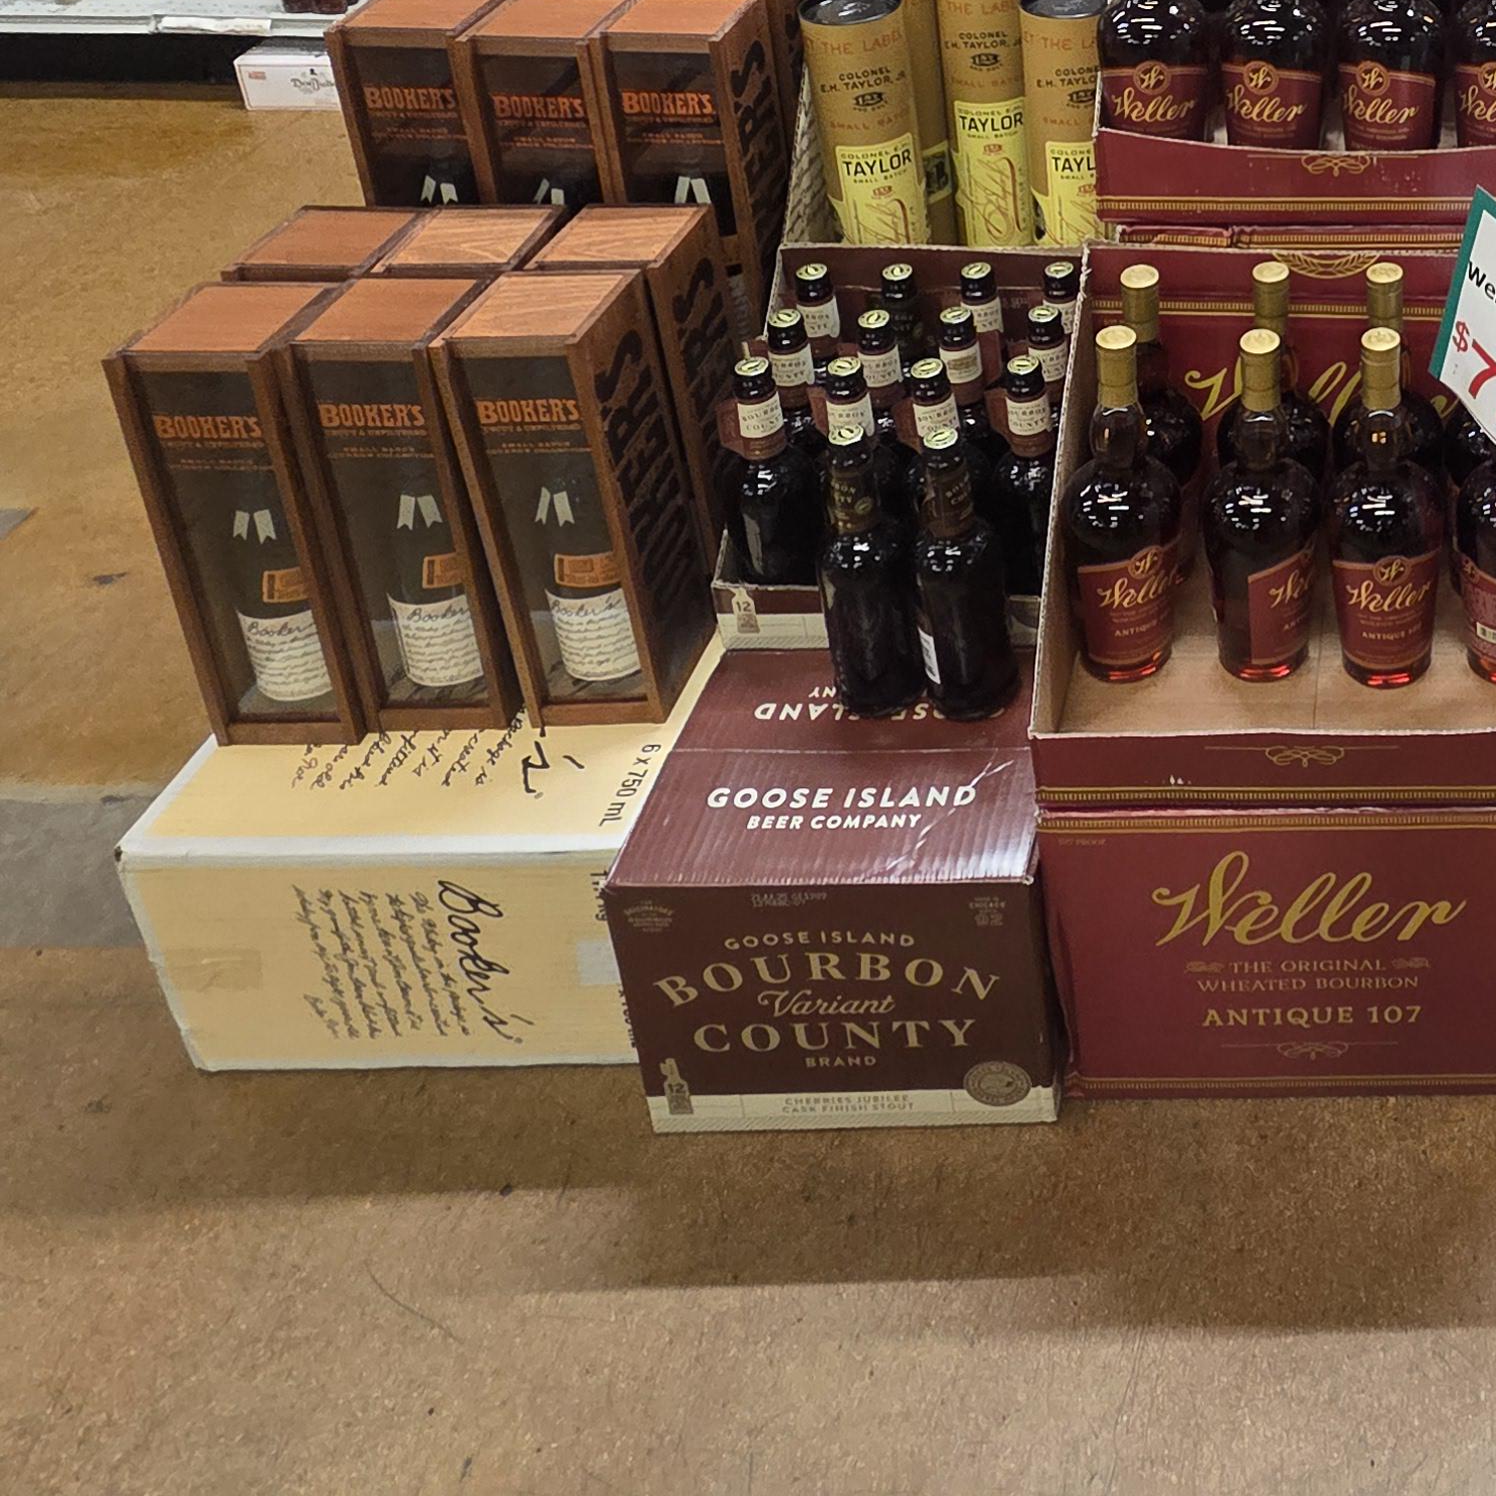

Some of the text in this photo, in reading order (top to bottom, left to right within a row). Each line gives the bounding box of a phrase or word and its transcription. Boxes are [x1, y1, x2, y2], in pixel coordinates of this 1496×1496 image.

[838, 67, 892, 82] COLONEL
[364, 87, 457, 111] BOOKER'S
[1111, 87, 1195, 124] Weller
[842, 150, 913, 177] TAYLOR
[319, 403, 425, 428] BOOKER'S
[475, 399, 581, 425] BOOKER'S
[153, 415, 262, 438] BOOKER'S
[642, 743, 662, 754] 6
[615, 767, 649, 797] 750
[705, 784, 977, 810] GOOSE ISLAND
[598, 800, 626, 827] mL
[746, 812, 922, 830] BEER COMPANY
[1151, 849, 1468, 948] Weller
[723, 930, 915, 951] GOOSE ISLAND
[437, 879, 535, 1044] Booker's
[1228, 958, 1388, 974] THE ORIGINAL
[652, 951, 1002, 1008] BOURBON
[1195, 975, 1419, 993] WHEATED BOURBON
[757, 989, 896, 1019] Variant
[1202, 1005, 1423, 1029] ANTIQUE 107
[693, 1017, 978, 1054] COUNTY
[804, 1054, 877, 1069] BRAND
[667, 1083, 686, 1094] 12
[782, 1101, 915, 1114] CASK FINISH STOUT
